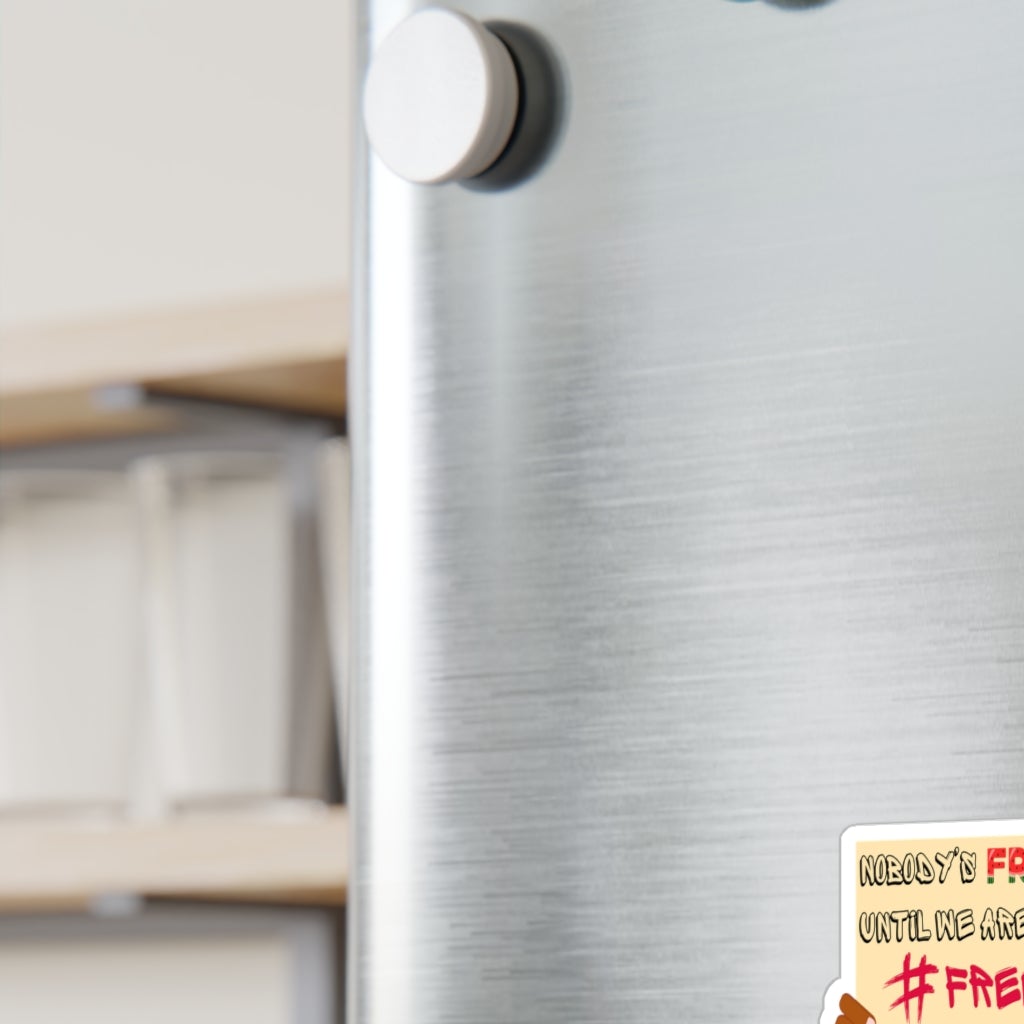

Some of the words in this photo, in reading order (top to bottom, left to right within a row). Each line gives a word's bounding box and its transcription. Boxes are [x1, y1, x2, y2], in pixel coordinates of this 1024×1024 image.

[859, 847, 976, 887] NOBODY'S
[859, 909, 931, 943] UNTIL
[935, 908, 975, 942] WE
